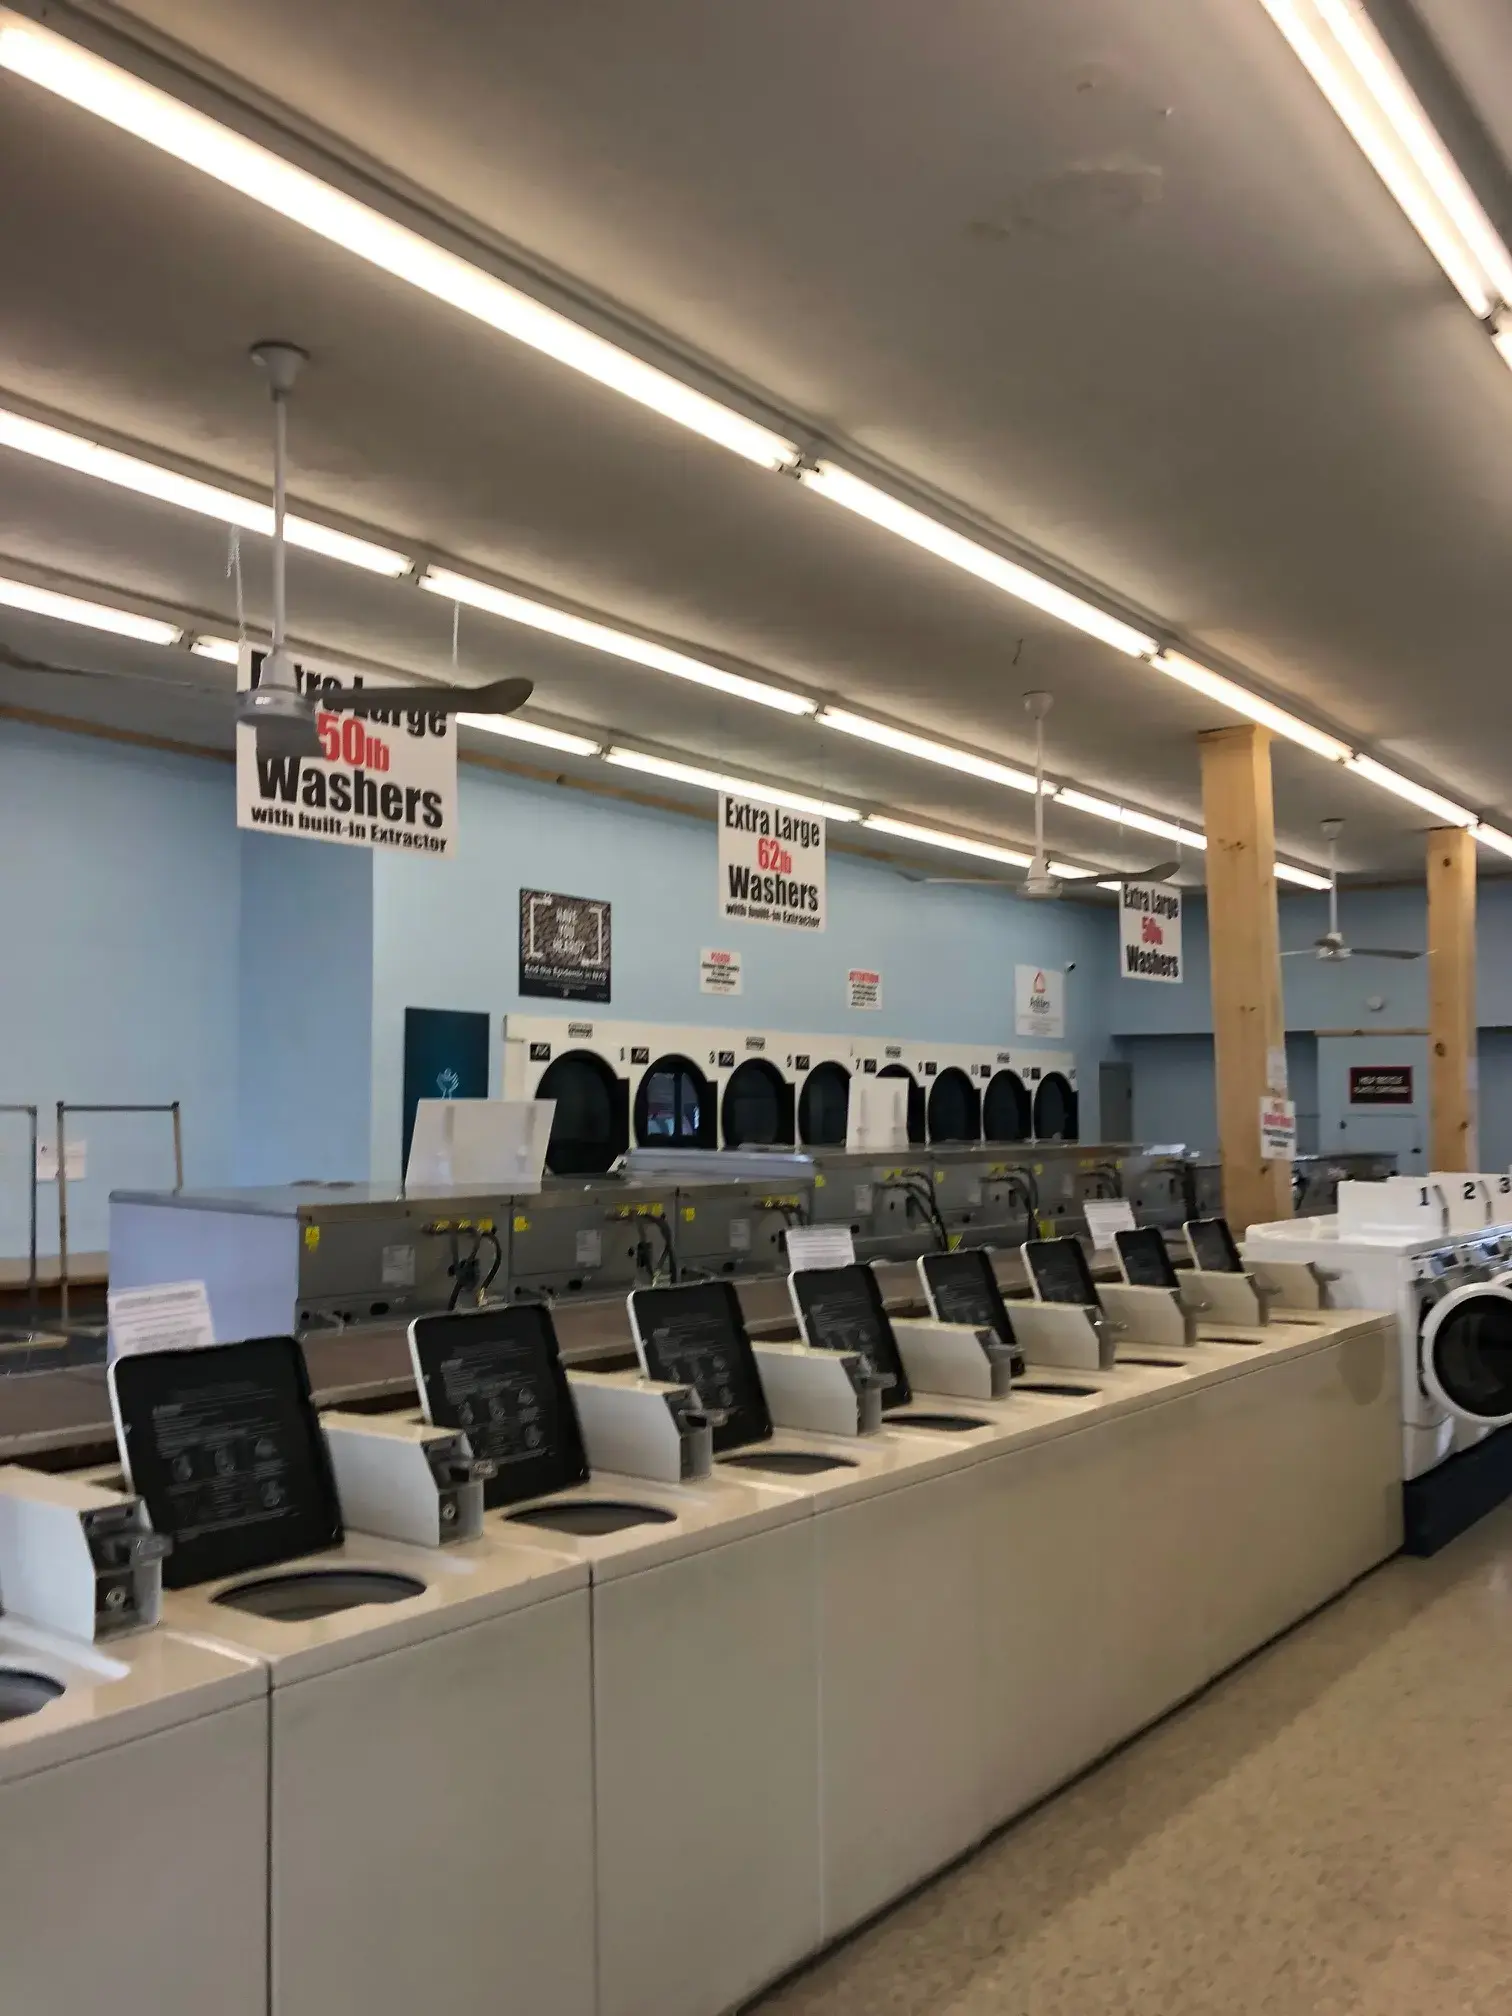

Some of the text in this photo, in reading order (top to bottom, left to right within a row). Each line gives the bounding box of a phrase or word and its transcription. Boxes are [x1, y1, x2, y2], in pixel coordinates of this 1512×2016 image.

[317, 712, 389, 772] 50lb
[257, 753, 443, 829] Washers
[251, 806, 447, 852] with built-in Extractor
[725, 797, 820, 848] Extra Large
[758, 837, 792, 874] 62lb
[728, 863, 818, 911] Washers
[1123, 884, 1178, 919] Extra Large
[725, 902, 747, 917] with
[783, 910, 821, 928] Extractor
[1126, 944, 1179, 977] Washers
[620, 1046, 626, 1061] 1
[1419, 1186, 1430, 1207] 1
[1463, 1181, 1476, 1200] 2
[1499, 1177, 1511, 1194] 3
